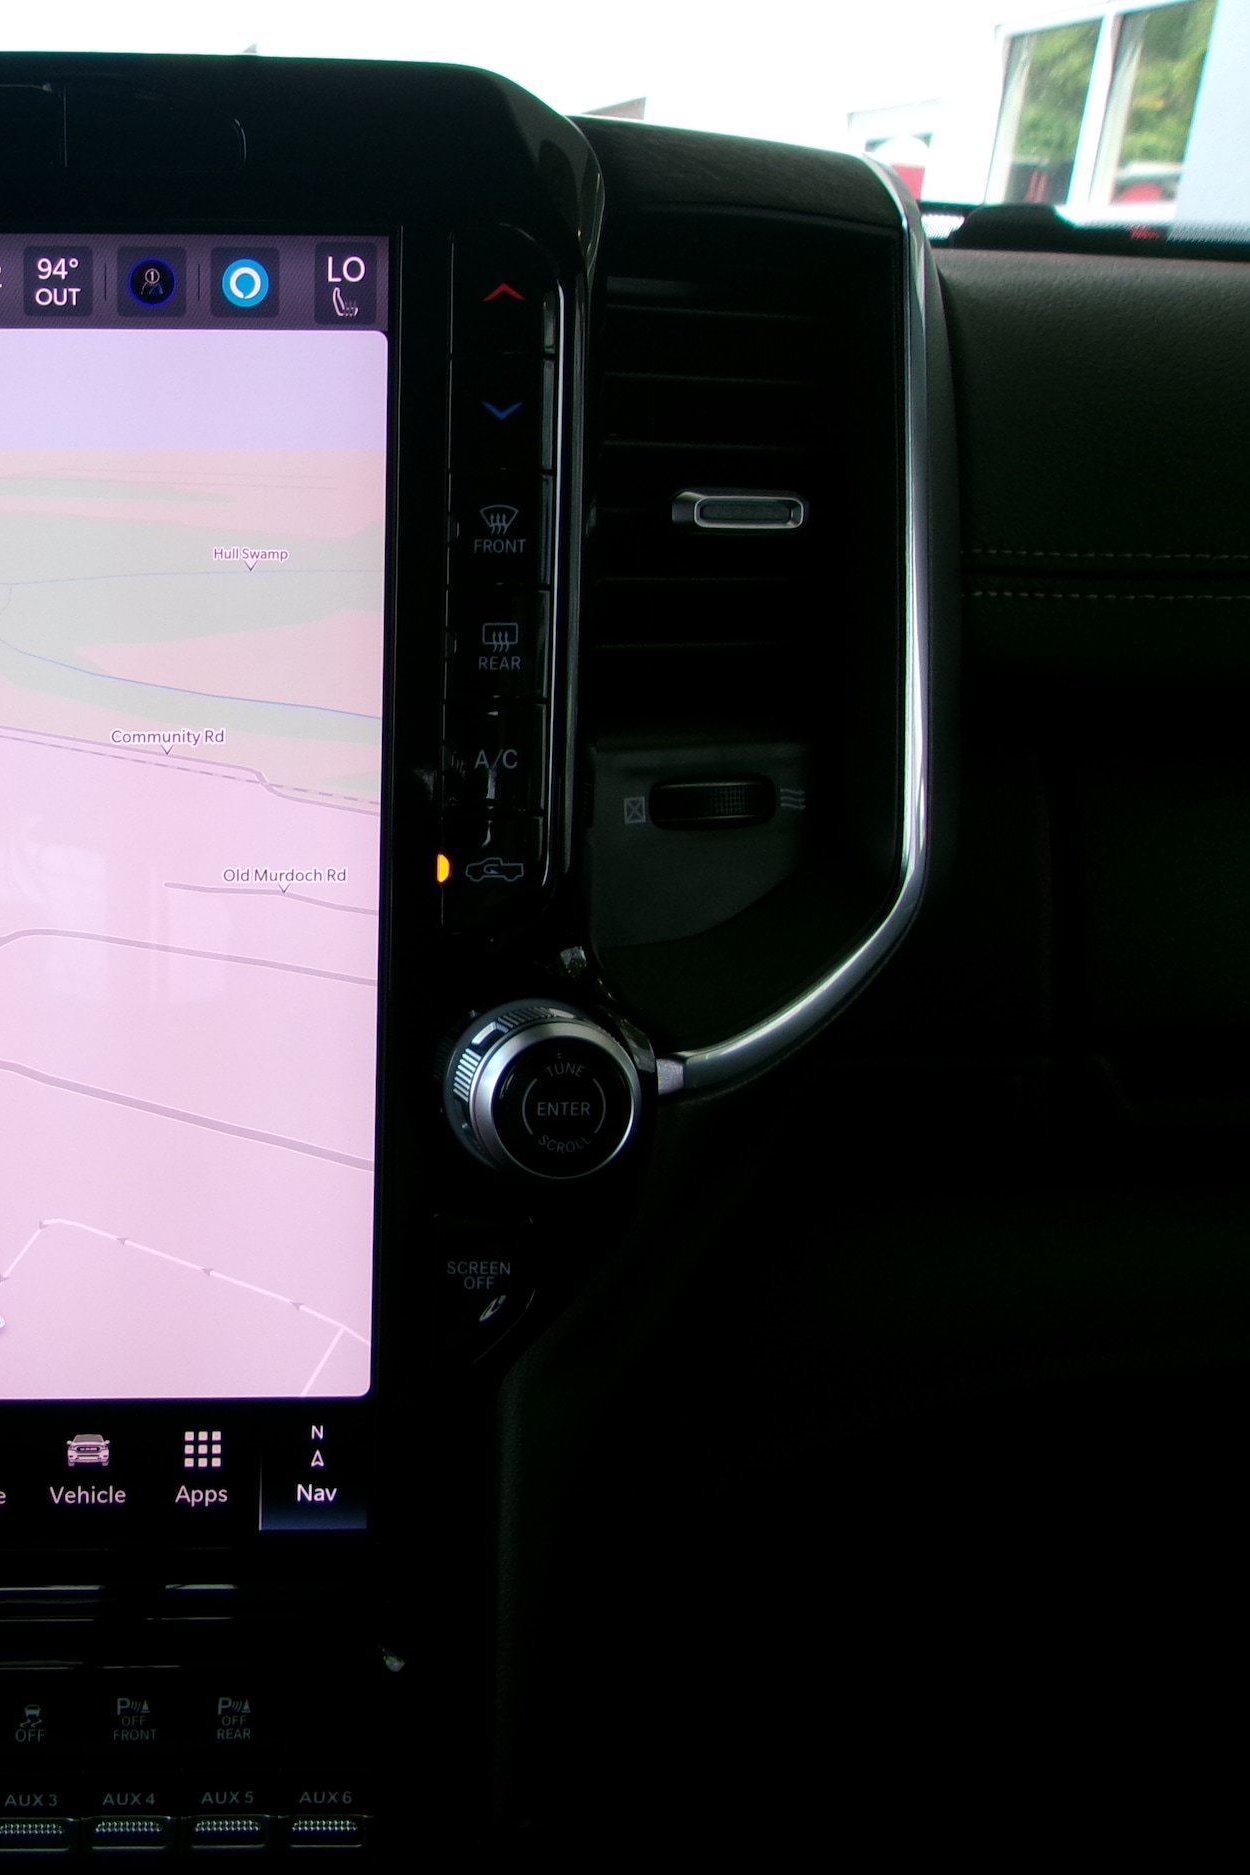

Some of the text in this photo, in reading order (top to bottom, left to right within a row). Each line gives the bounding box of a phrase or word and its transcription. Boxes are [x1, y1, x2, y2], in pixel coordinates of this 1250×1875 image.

[37, 257, 79, 280] 94°
[326, 256, 365, 282] LO
[35, 288, 81, 306] OUT
[473, 538, 526, 554] FRONT
[214, 548, 288, 562] Hull Swamp
[478, 655, 521, 671] REAR
[111, 730, 225, 746] Community Rd
[475, 748, 518, 769] A/C
[223, 869, 347, 882] Old Murdoch Rd
[546, 1063, 585, 1079] TUNE
[537, 1102, 591, 1117] ENTER
[538, 1135, 592, 1154] SCROLL
[447, 1262, 511, 1275] SCREEN
[464, 1276, 495, 1290] OFF
[311, 1425, 323, 1440] N
[50, 1486, 126, 1505] Vehicle
[175, 1486, 228, 1508] Apps
[297, 1484, 337, 1501] Nav
[121, 1715, 147, 1727] OFF
[221, 1715, 247, 1727] OFF
[14, 1729, 46, 1742] OFF
[112, 1729, 157, 1741] FRONT
[216, 1728, 251, 1740] REAR
[4, 1794, 58, 1807] AUX 3
[101, 1793, 156, 1806] AUX 4
[200, 1791, 254, 1805] AUX 5
[298, 1791, 352, 1804] AUX 6
